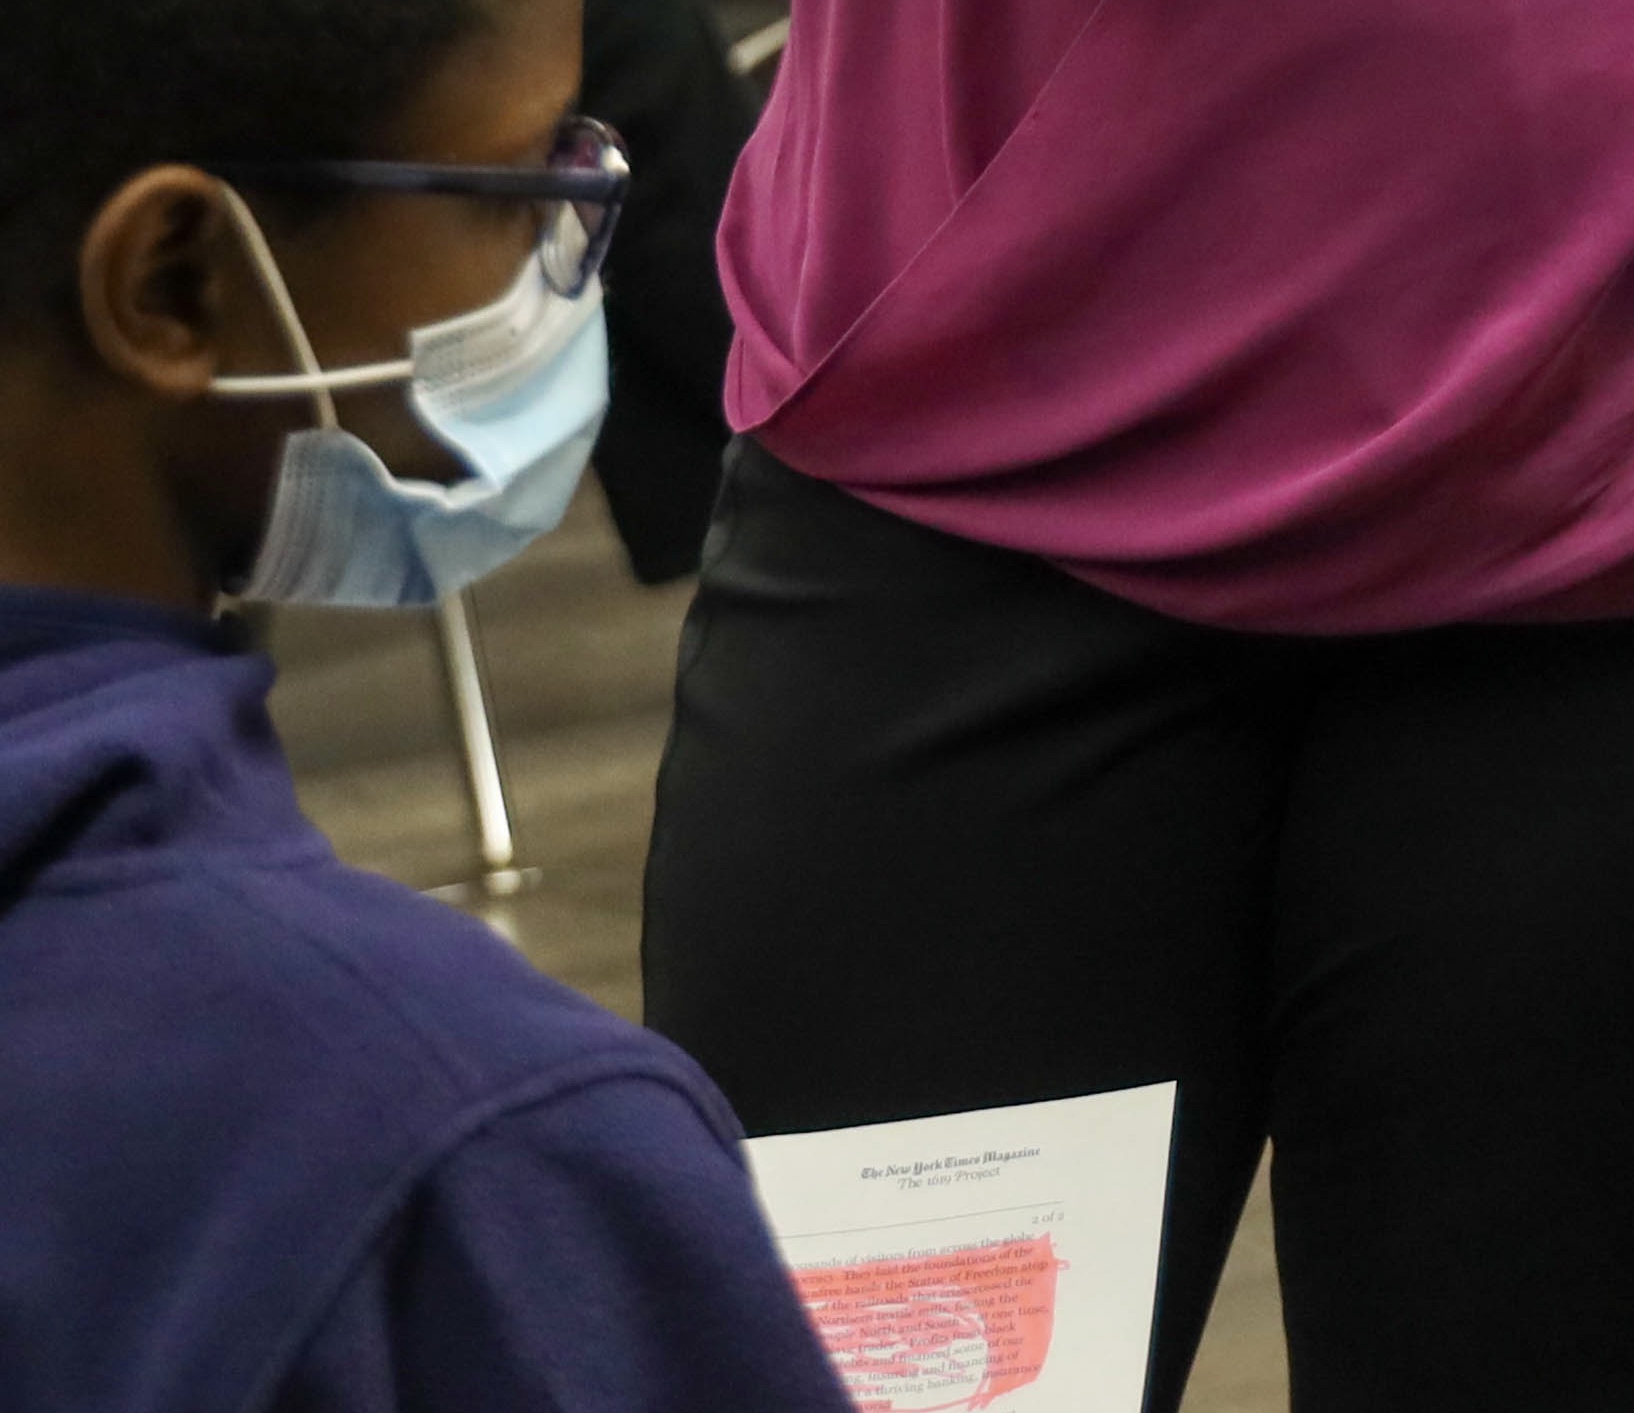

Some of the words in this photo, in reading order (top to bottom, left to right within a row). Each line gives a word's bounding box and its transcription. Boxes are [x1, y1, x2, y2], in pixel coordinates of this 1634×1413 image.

[861, 1166, 884, 1180] The
[885, 1164, 911, 1177] New
[913, 1158, 943, 1176] York
[944, 1155, 981, 1170] Times
[983, 1146, 1041, 1166] Magazine
[897, 1177, 922, 1191] The
[927, 1174, 952, 1187] 1619
[953, 1166, 1001, 1183] Project
[1041, 1210, 1055, 1223] of
[902, 1261, 921, 1274] the
[1014, 1244, 1034, 1257] the
[885, 1277, 905, 1291] the
[964, 1263, 1018, 1281] Freedom
[999, 1290, 1018, 1304] the
